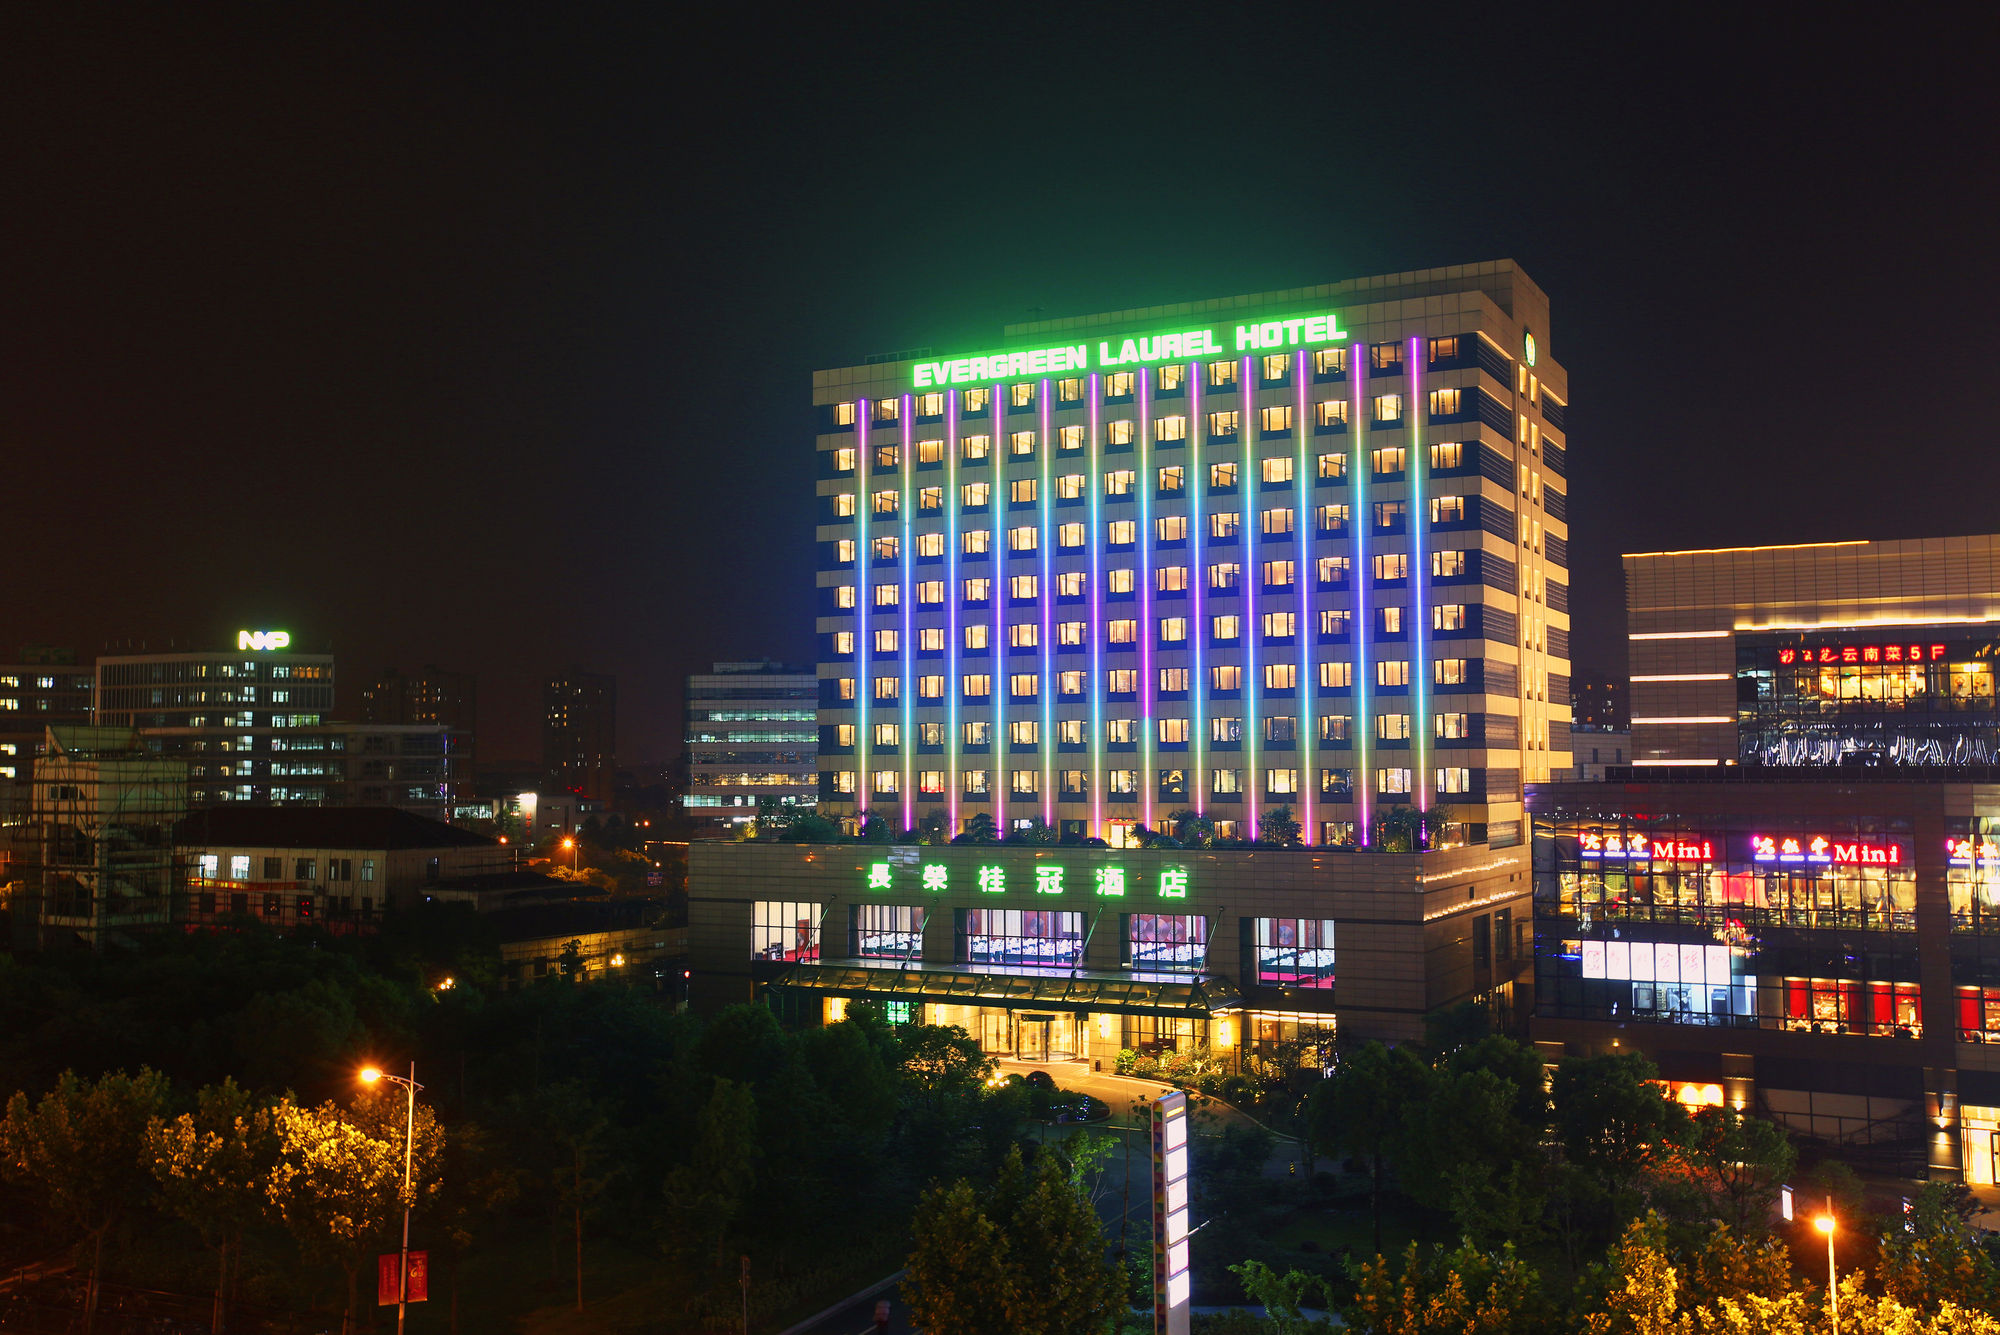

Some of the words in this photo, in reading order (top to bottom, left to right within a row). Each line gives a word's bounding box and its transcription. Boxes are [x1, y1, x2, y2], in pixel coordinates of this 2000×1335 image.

[913, 345, 1087, 388] EVERGREEN
[1099, 329, 1223, 366] LAUREL
[1236, 314, 1348, 352] HOTEL
[238, 629, 290, 651] NXP
[1652, 841, 1712, 859] Mini
[1834, 844, 1899, 863] Mini
[867, 863, 1189, 899] 長榮桂冠酒店
